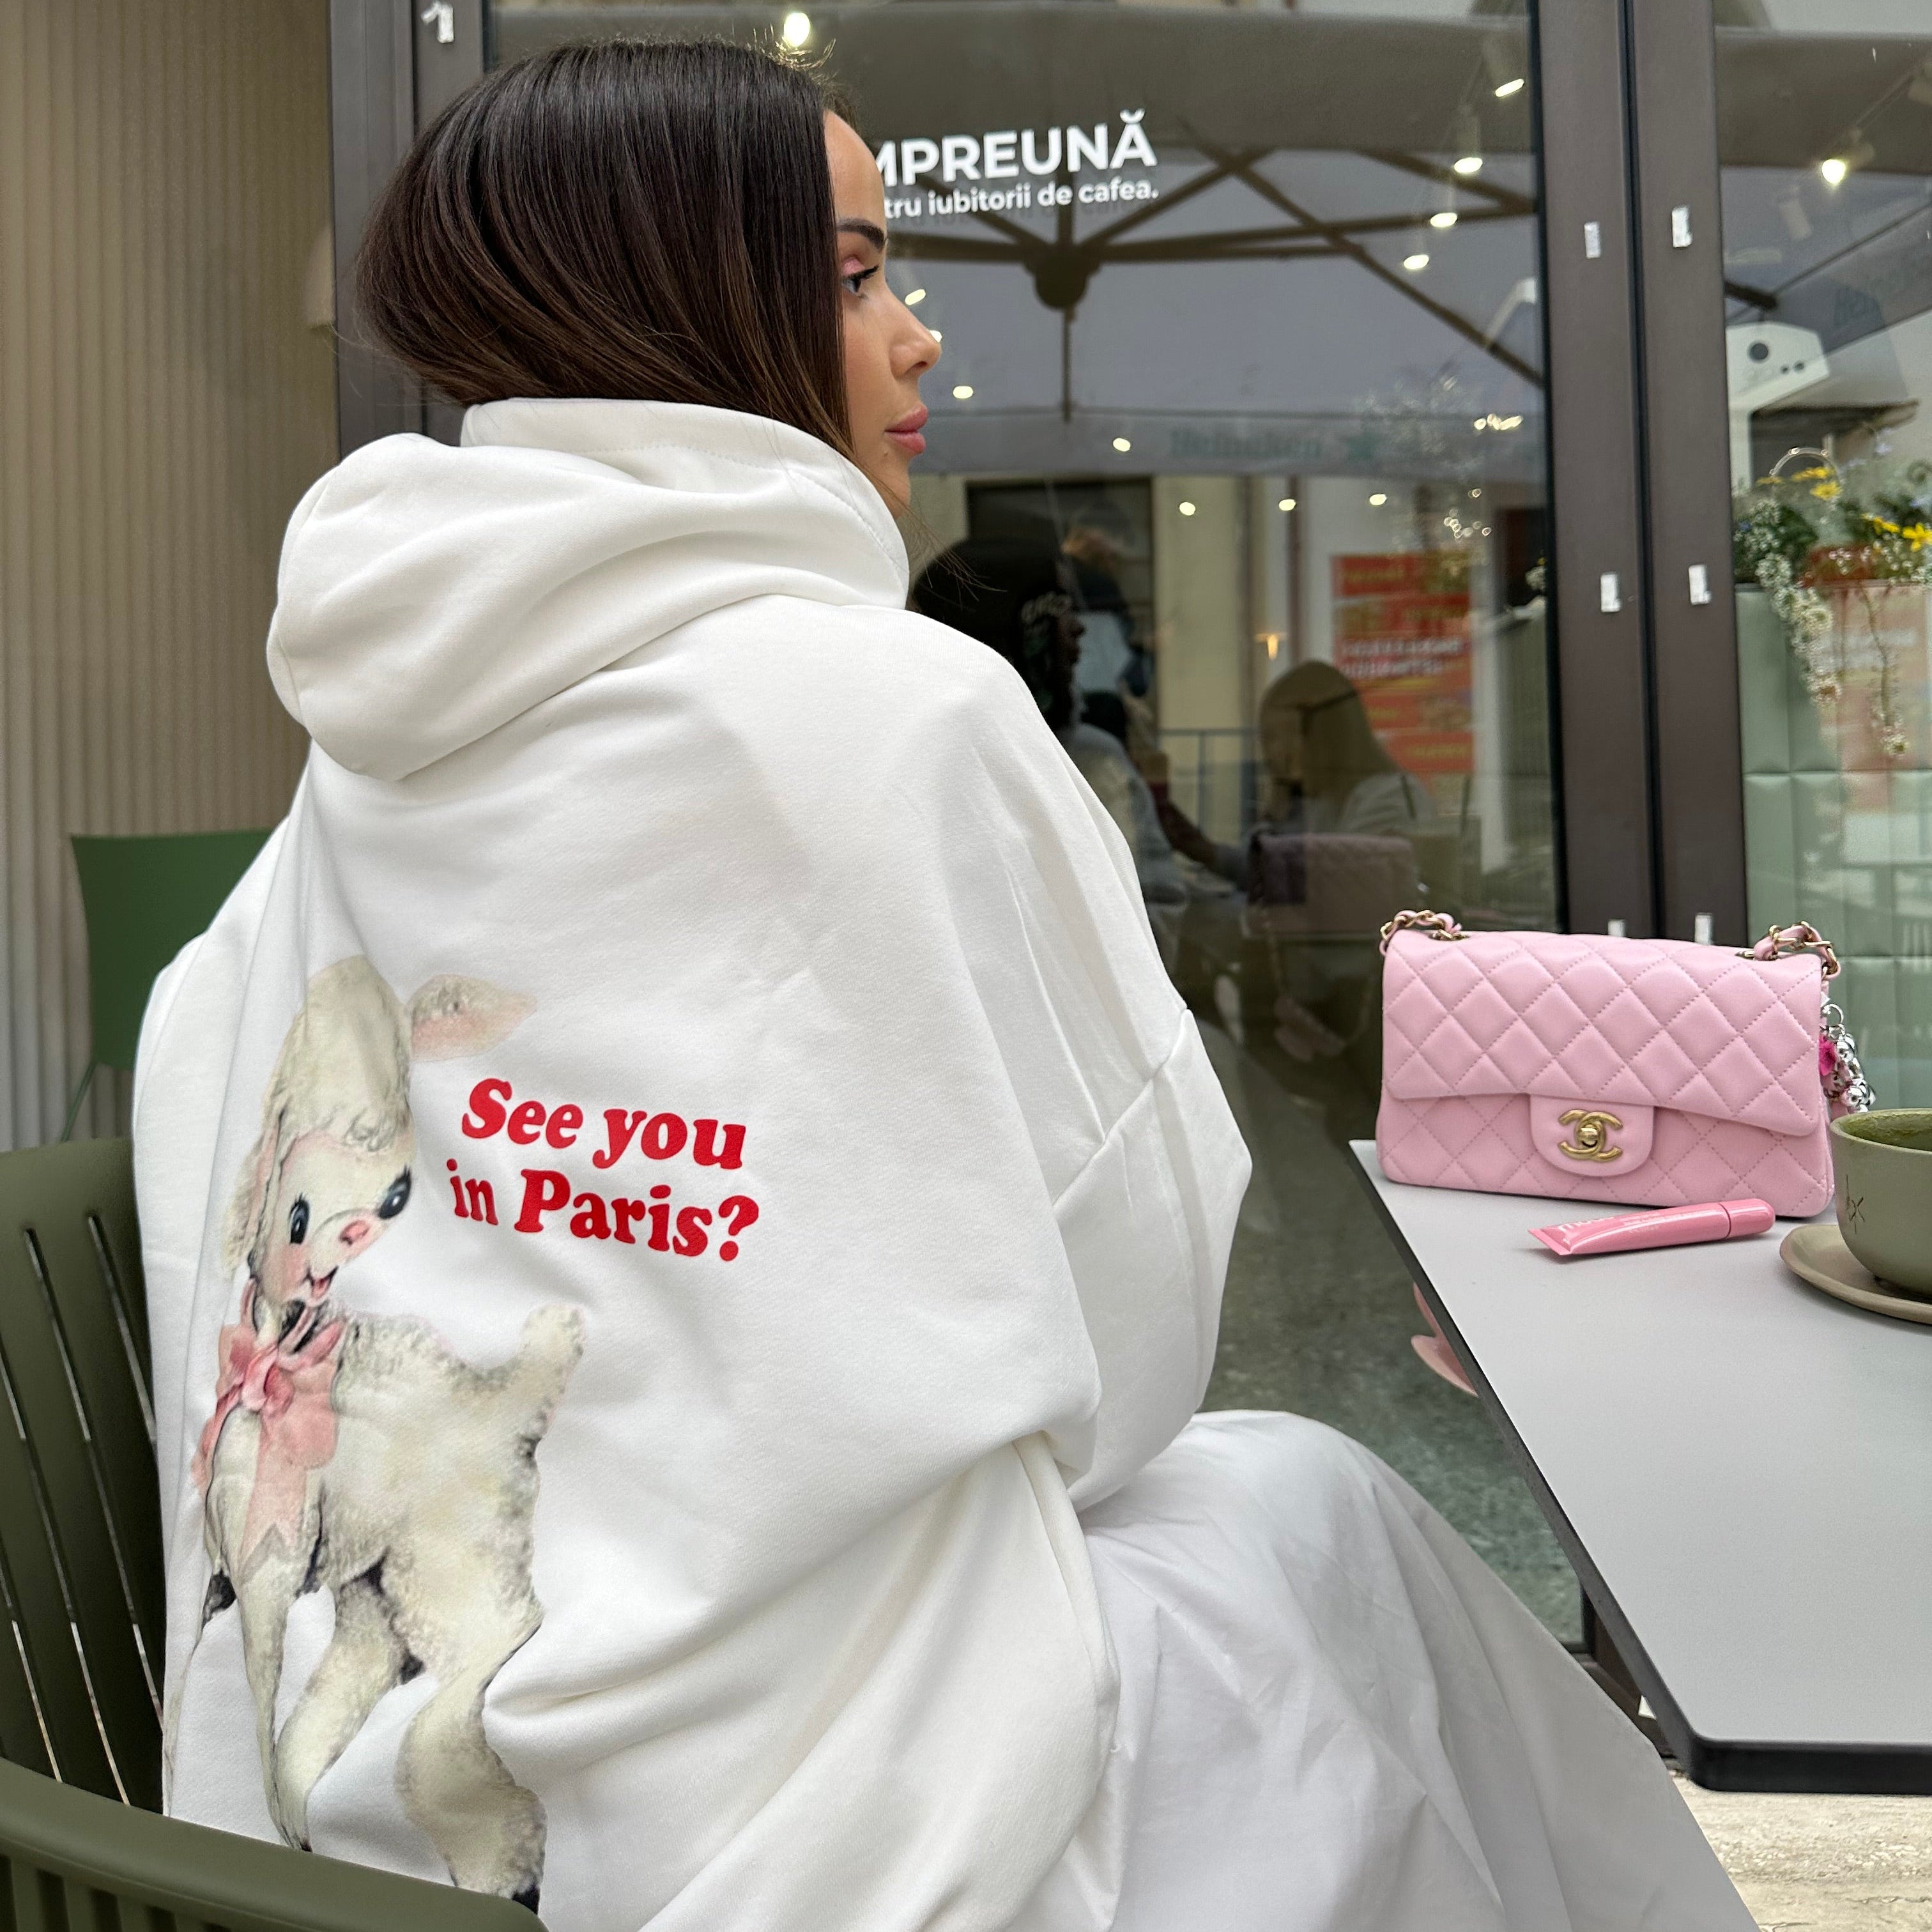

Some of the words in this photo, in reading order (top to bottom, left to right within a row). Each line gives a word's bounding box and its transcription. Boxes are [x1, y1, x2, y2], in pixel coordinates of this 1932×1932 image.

[928, 182, 1032, 216] iubitorii
[1036, 180, 1073, 207] de
[1078, 175, 1160, 204] cafea.
[461, 1077, 584, 1149] See
[592, 1108, 747, 1170] you
[446, 1158, 498, 1226] in
[514, 1169, 760, 1262] Paris?
